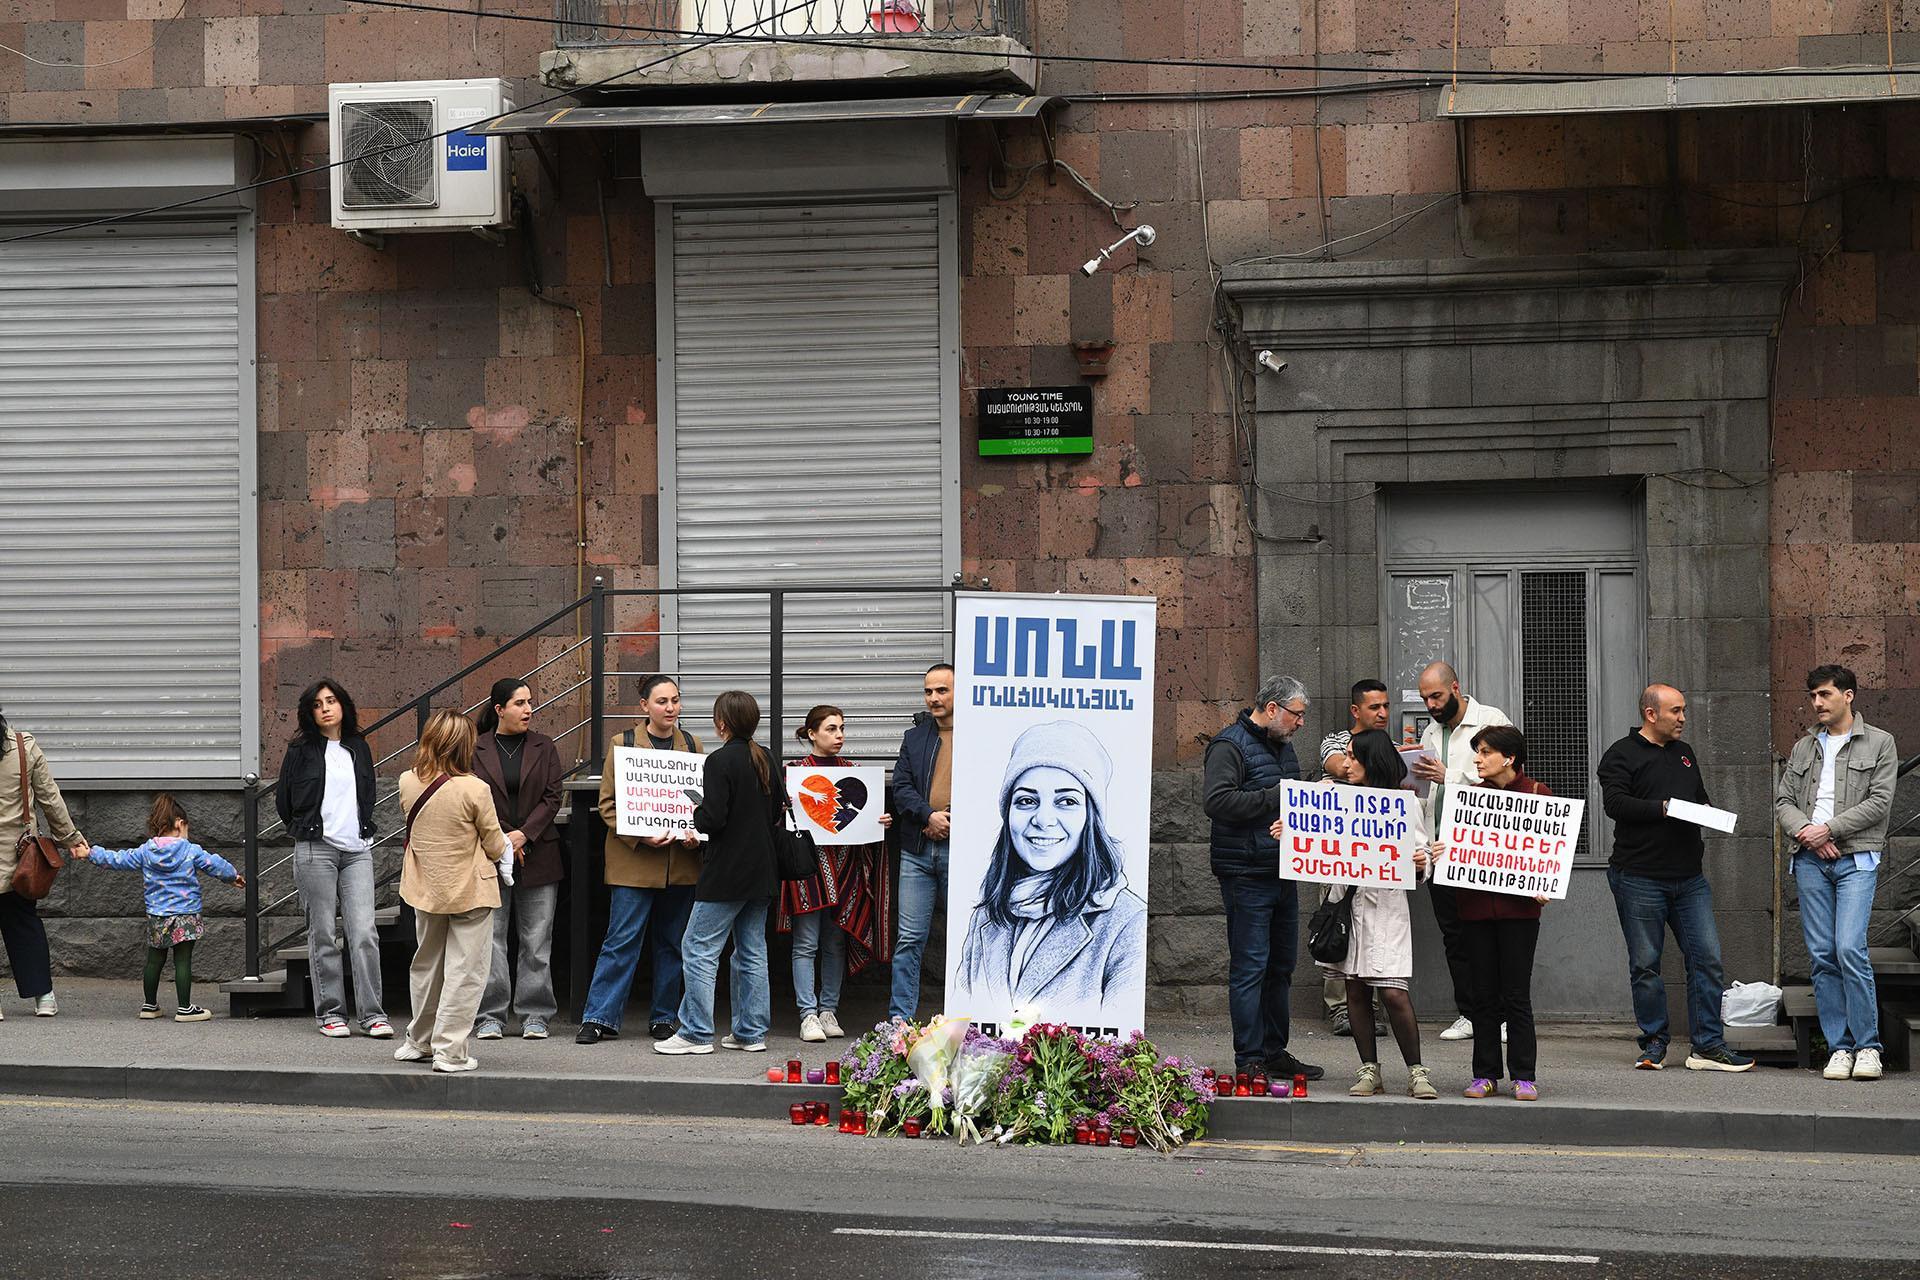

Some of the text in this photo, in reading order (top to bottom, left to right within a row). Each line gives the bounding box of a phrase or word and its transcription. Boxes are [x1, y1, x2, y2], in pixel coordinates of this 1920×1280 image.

[448, 145, 485, 157] Haier
[1007, 392, 1063, 401] YOUNG TIME
[973, 616, 1142, 680] ՍՈՆԱ
[625, 757, 697, 772] ՊԱՀԱՆՋՈՒՄ
[626, 771, 704, 787] ՍԱՀՄԱՆԱՓԱ
[1355, 794, 1406, 817] ՈՏՔԴ
[1545, 802, 1570, 818] ԵՆՔ
[627, 815, 697, 830] ԱՐԱԳՈՒԹՅ
[1454, 808, 1567, 836] ՍԱՀՄԱՆԱՓԱԿԵԼ
[1293, 836, 1401, 861] ՄԱՐԴ
[1452, 827, 1566, 855] ՄԱՀԱԲԵՐ
[1291, 857, 1373, 879] ՉՄԵՌՆԻ
[1449, 847, 1561, 874] ՇԱՐԱՍՅՈՒՆՆԵՐԻ
[1447, 865, 1558, 893] ԱՐԱԳՈՒԹՅՈՒՆԸ
